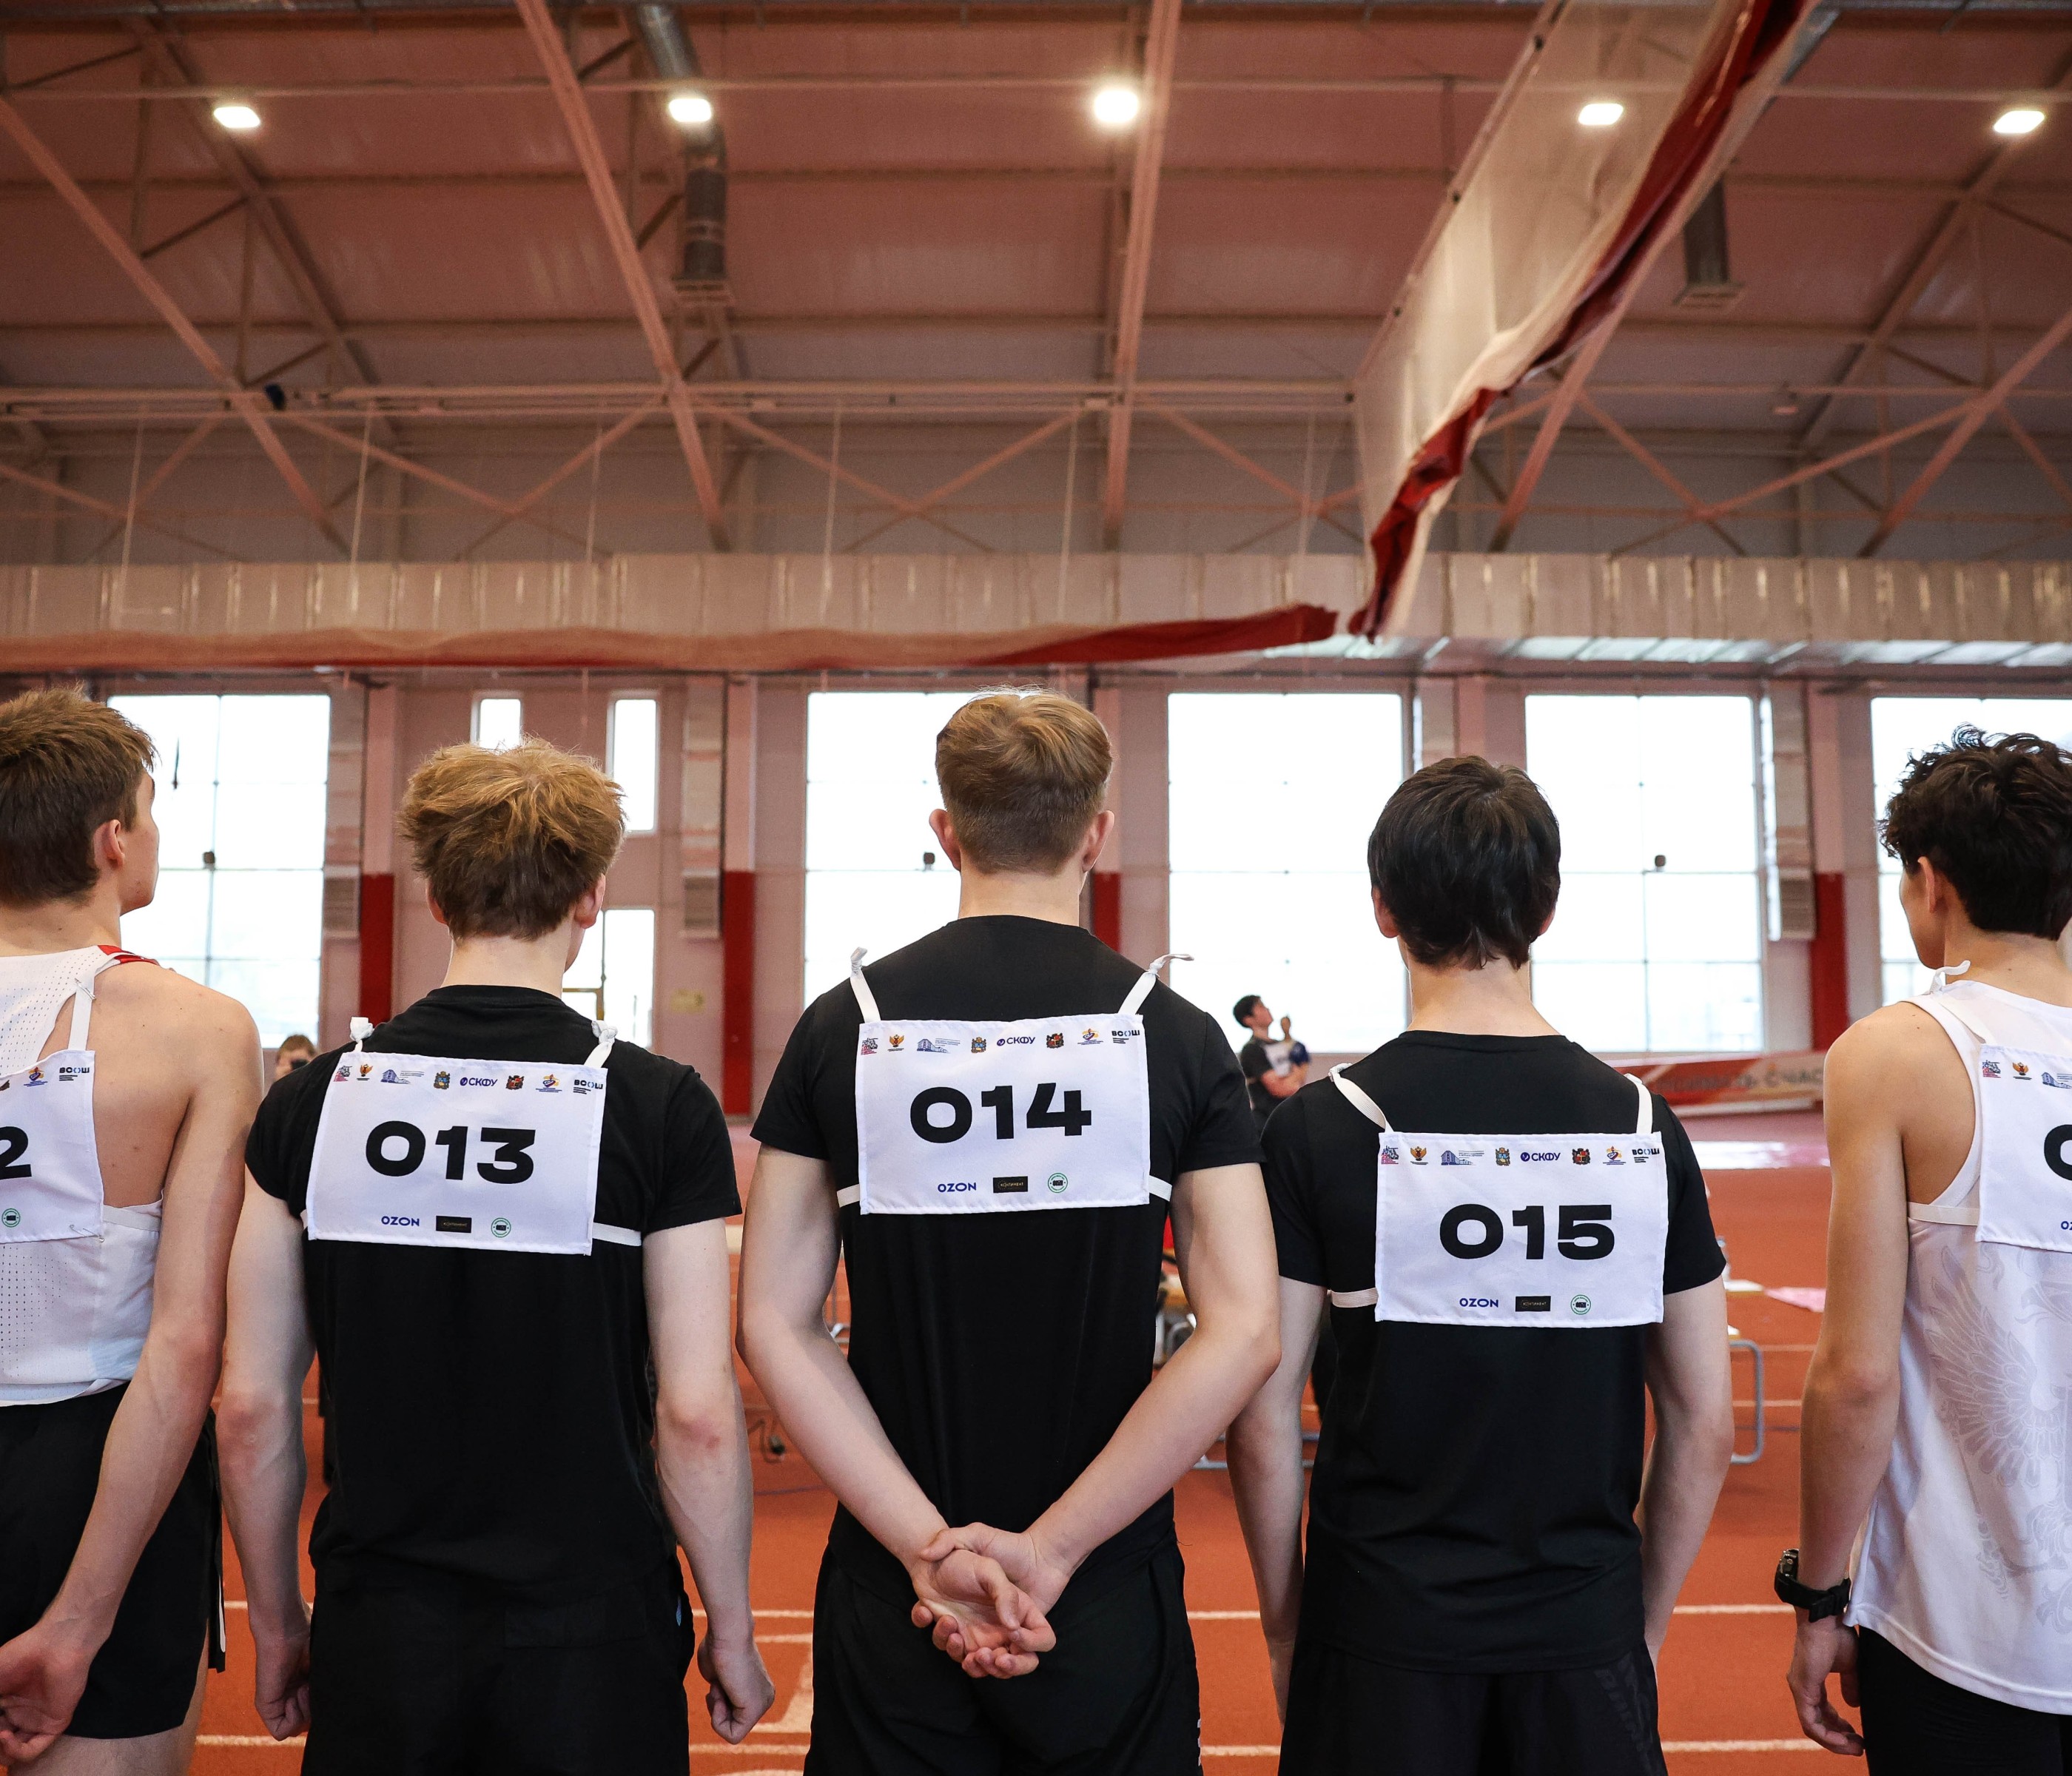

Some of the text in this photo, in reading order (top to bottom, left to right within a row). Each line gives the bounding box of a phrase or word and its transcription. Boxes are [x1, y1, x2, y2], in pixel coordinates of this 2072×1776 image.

[1006, 1036, 1036, 1045] СКФУ
[468, 1077, 498, 1086] СКФУ
[910, 1083, 1092, 1144] 014
[365, 1121, 536, 1185] 013
[1531, 1152, 1561, 1161] СКФУ
[938, 1182, 977, 1193] OZON
[381, 1215, 420, 1227] OZON
[1439, 1203, 1615, 1261] 015
[1459, 1297, 1499, 1308] OZON
